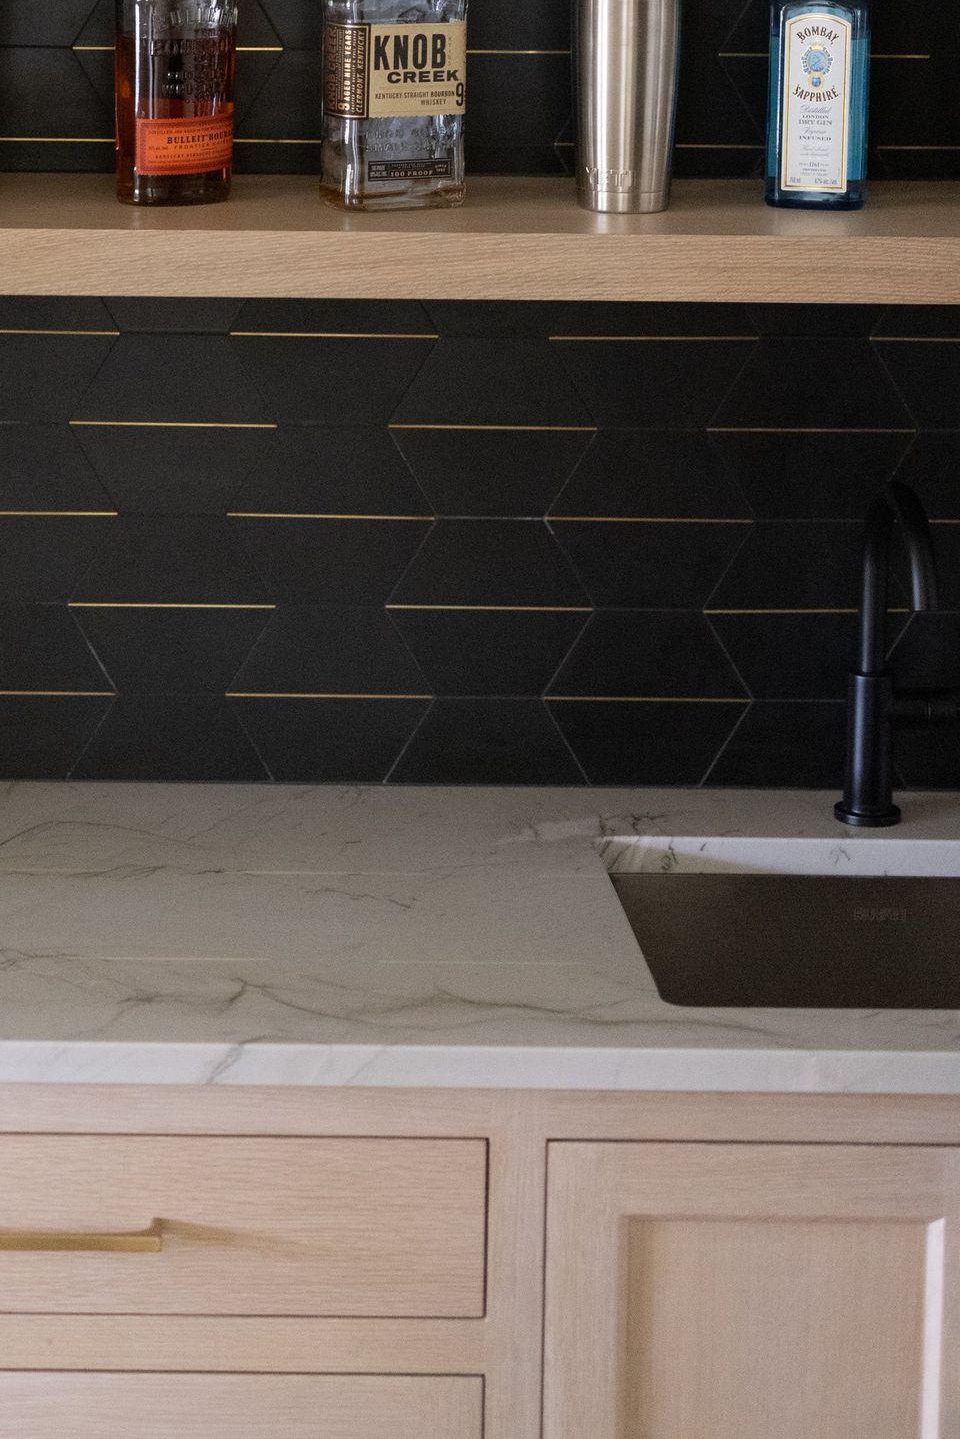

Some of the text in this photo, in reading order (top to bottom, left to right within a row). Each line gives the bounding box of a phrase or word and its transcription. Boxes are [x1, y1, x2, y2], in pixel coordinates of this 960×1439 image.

[796, 26, 840, 44] BOMBAY
[374, 34, 446, 71] KNOB
[387, 70, 459, 84] CREEK
[456, 82, 464, 106] 9
[793, 84, 839, 102] SAPPHIRE
[338, 102, 350, 111] 9
[167, 135, 206, 144] BULLEIT
